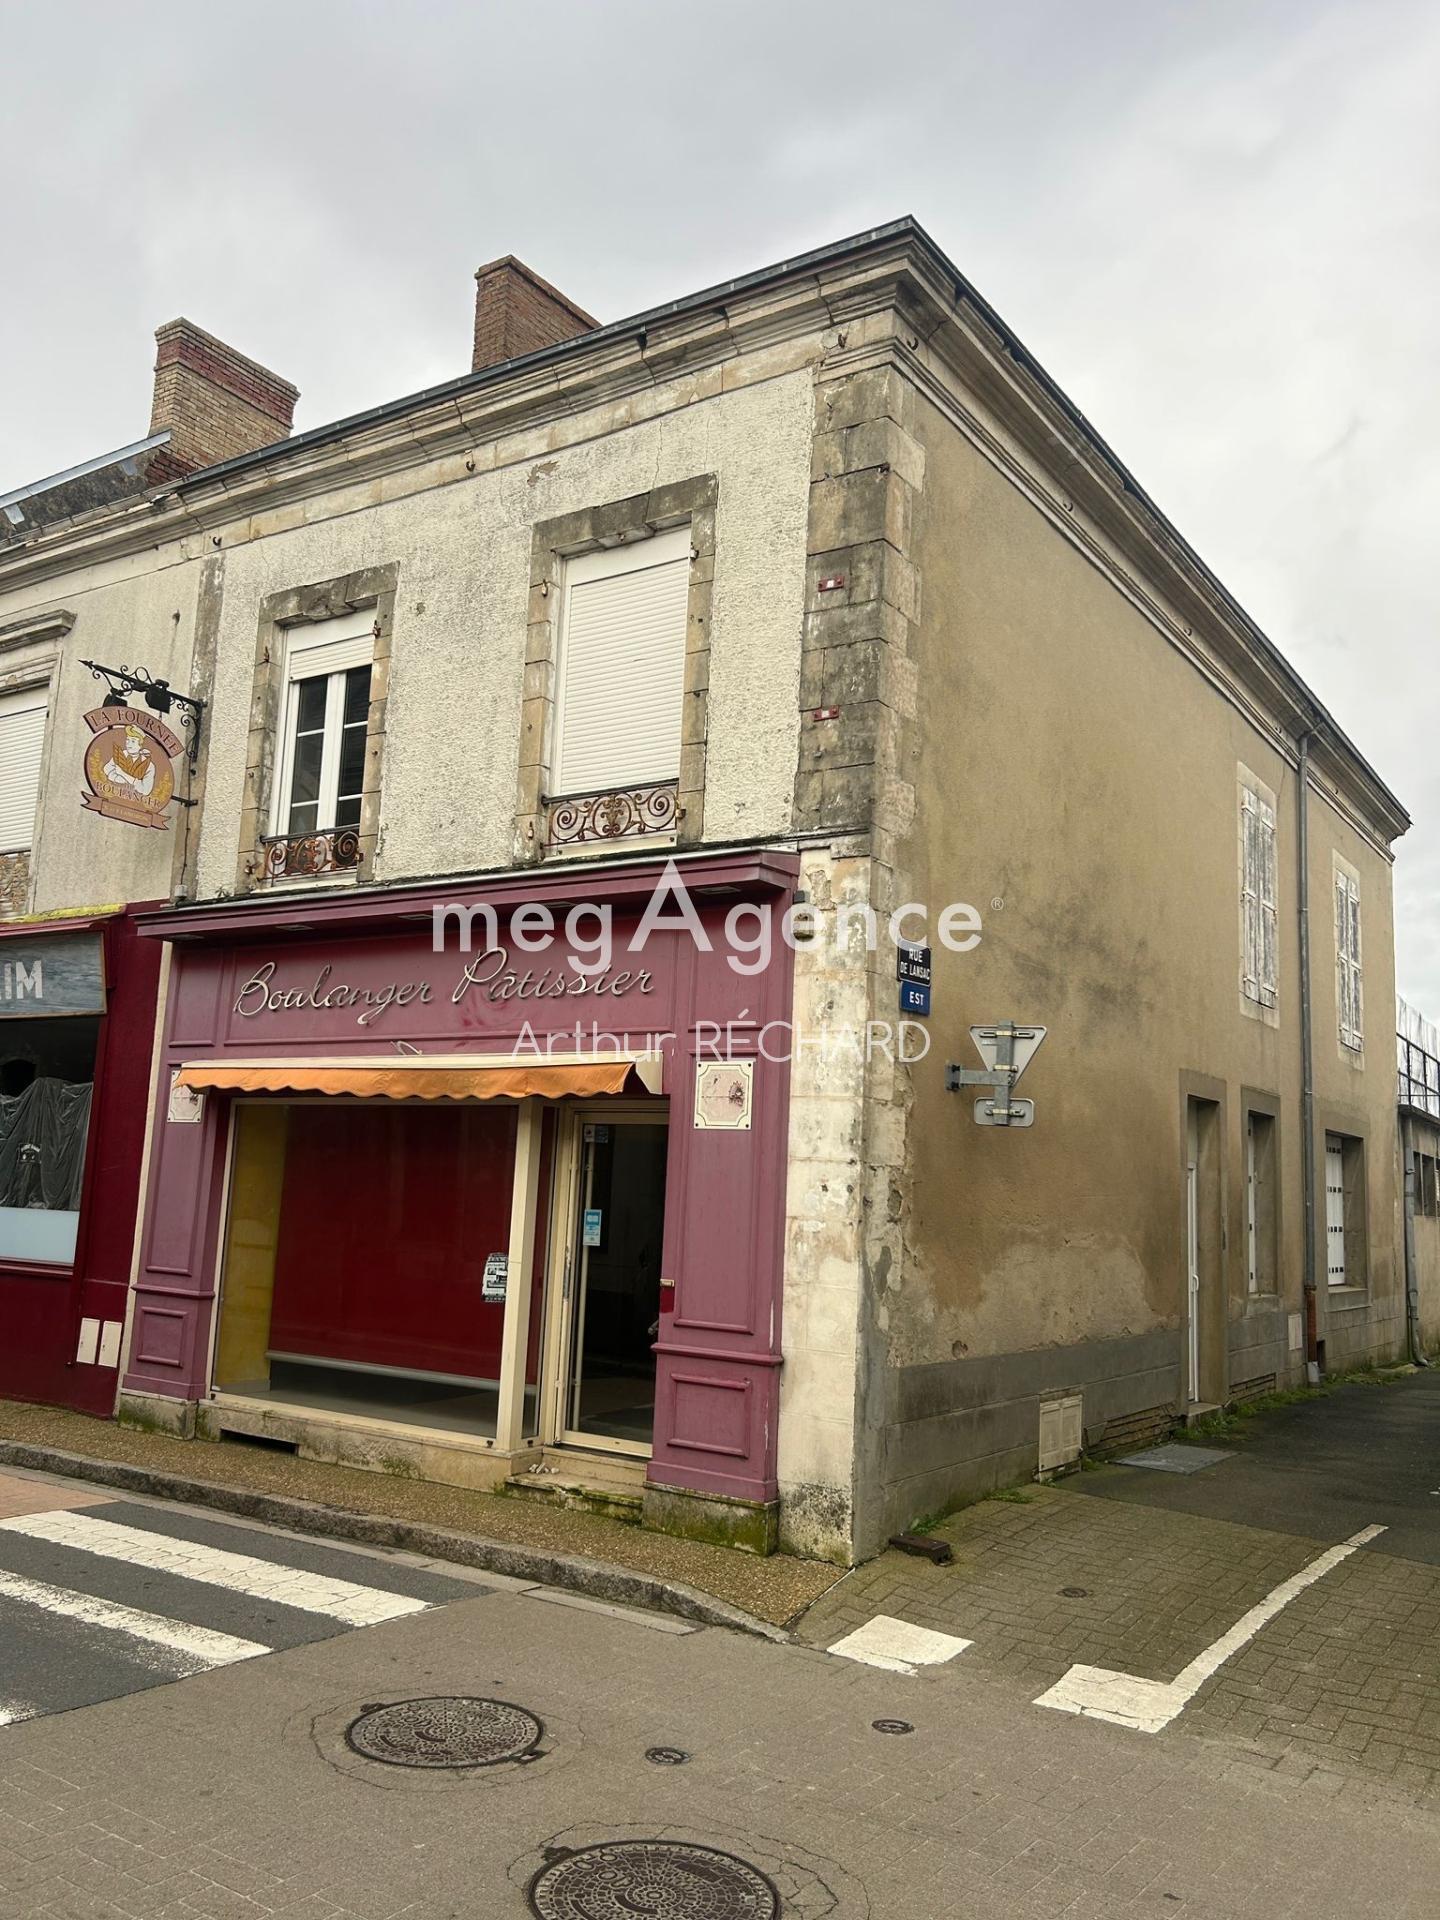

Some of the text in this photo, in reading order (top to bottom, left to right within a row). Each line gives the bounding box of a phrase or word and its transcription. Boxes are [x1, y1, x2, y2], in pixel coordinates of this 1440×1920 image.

[90, 711, 110, 727] LA
[909, 948, 923, 963] RUE
[900, 961, 908, 974] DE
[0, 960, 43, 1000] IM
[233, 946, 656, 1026] Boulanger Pâtissier
[909, 991, 924, 1006] EST
